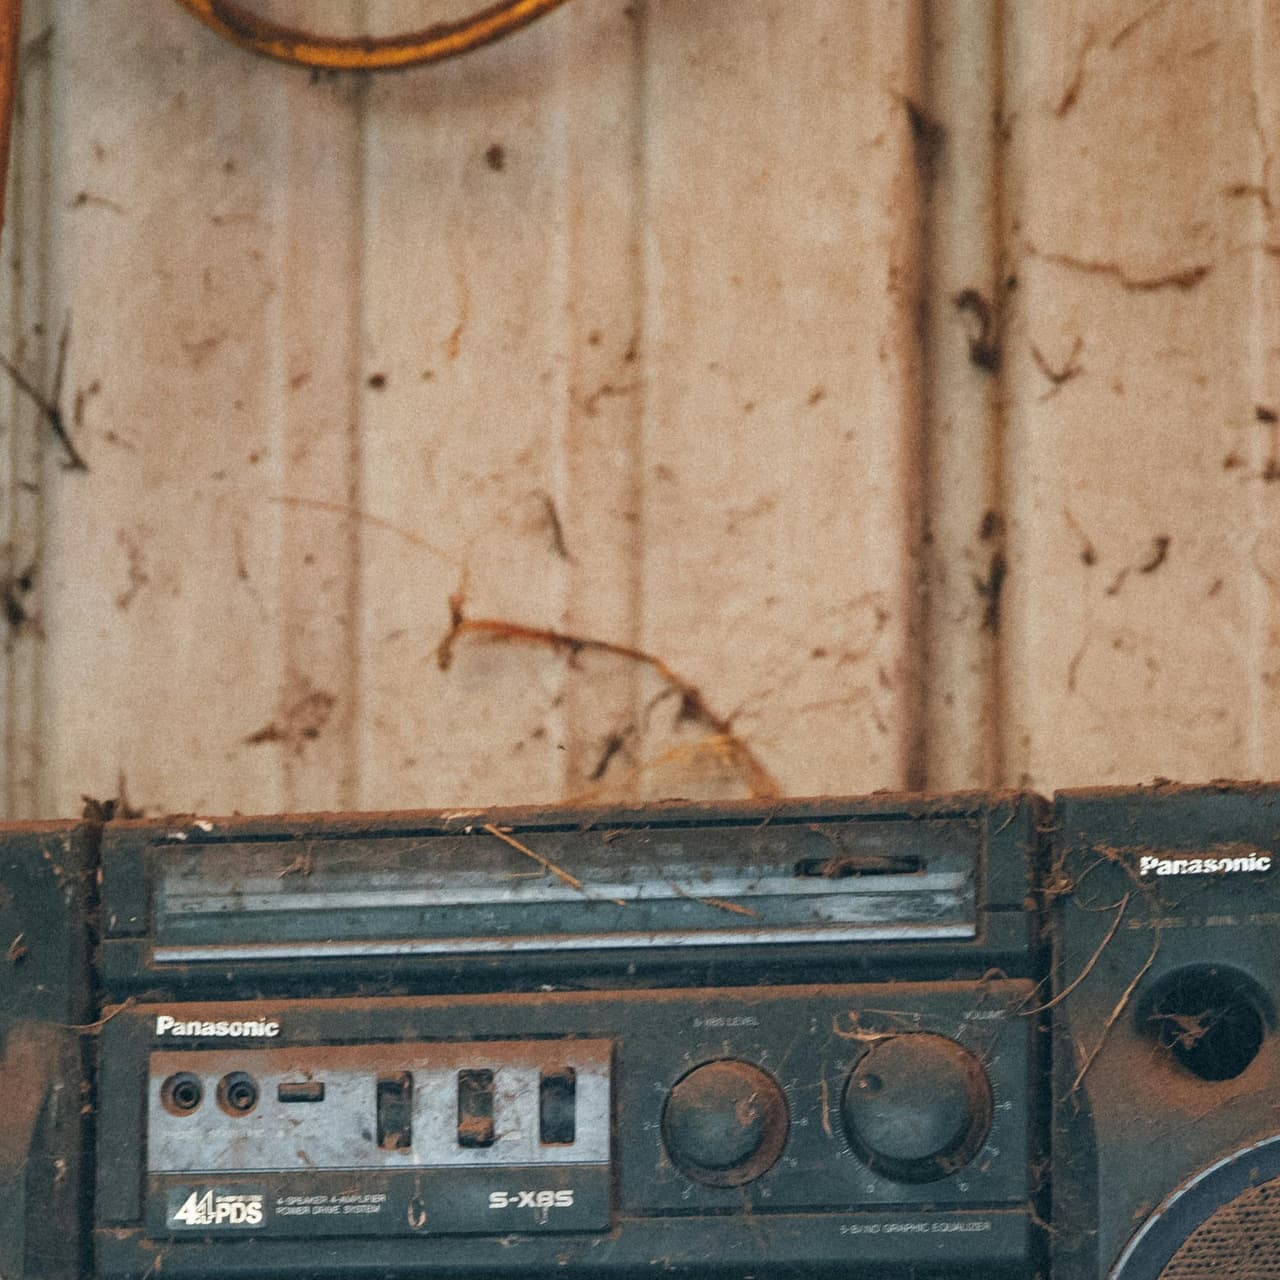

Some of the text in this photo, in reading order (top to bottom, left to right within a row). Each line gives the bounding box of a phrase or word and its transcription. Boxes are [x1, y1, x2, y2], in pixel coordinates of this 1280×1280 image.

[1140, 853, 1271, 876] Panasonic
[156, 1015, 280, 1037] Panasonic
[883, 1223, 929, 1233] GRAPHIC
[931, 1222, 992, 1232] EQUALIZER
